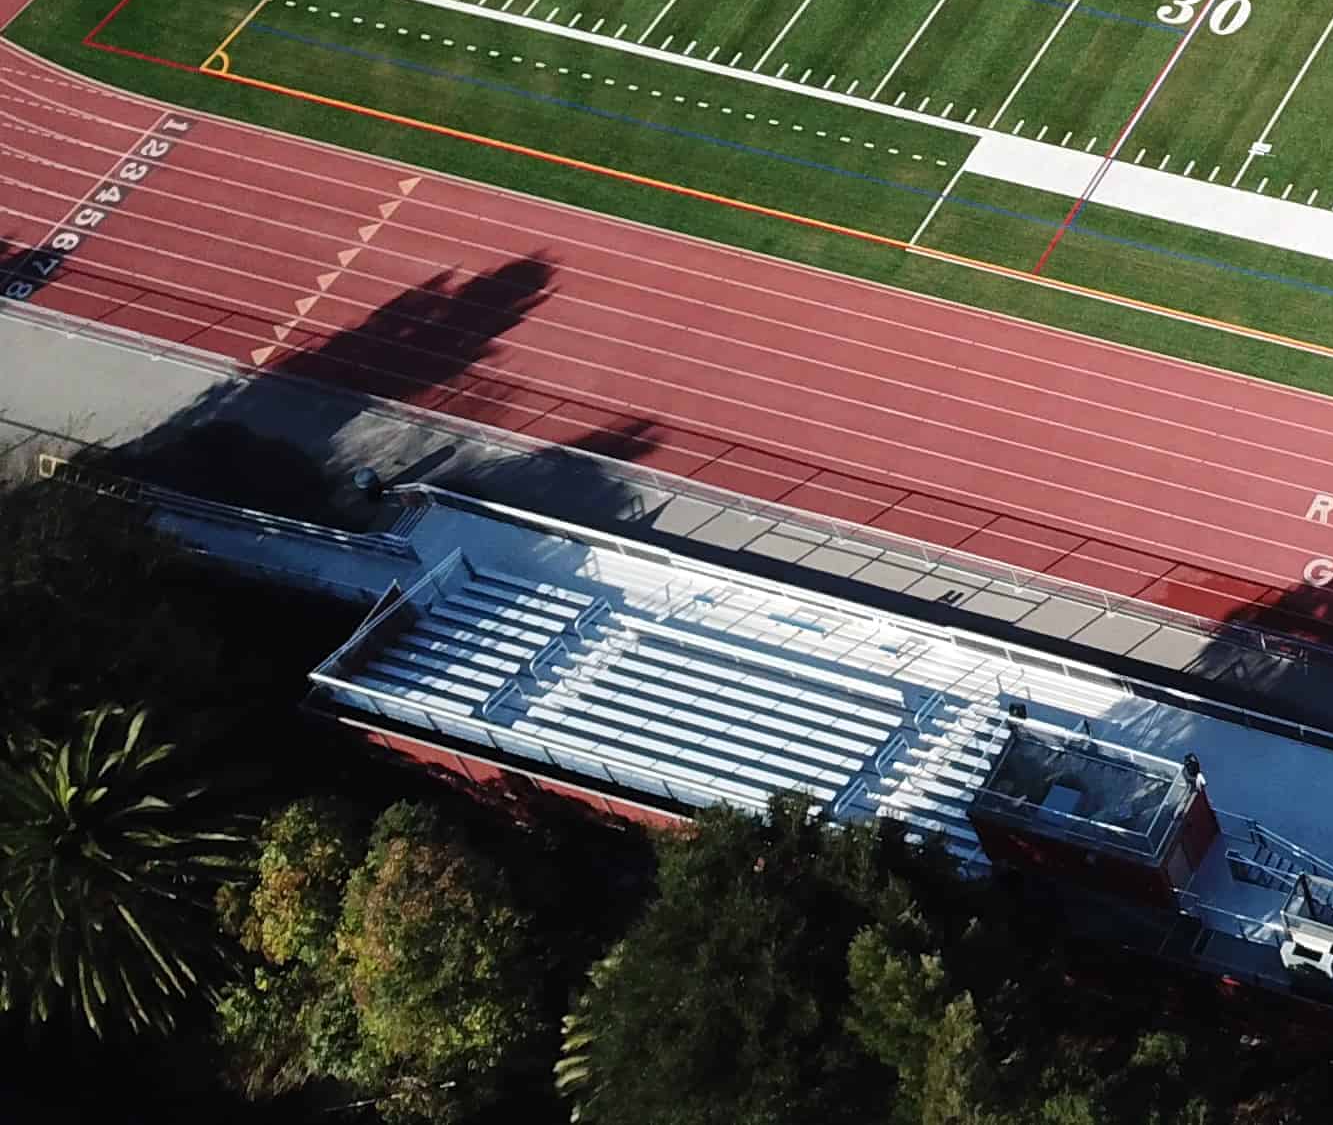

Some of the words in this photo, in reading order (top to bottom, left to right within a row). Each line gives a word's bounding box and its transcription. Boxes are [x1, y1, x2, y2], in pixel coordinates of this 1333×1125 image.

[162, 118, 188, 132] 1
[141, 139, 169, 157] 2
[119, 162, 148, 181] 3
[95, 185, 121, 204] 4
[74, 208, 105, 227] 5
[52, 232, 80, 251] 6
[33, 258, 60, 276] 7
[5, 281, 33, 299] 8
